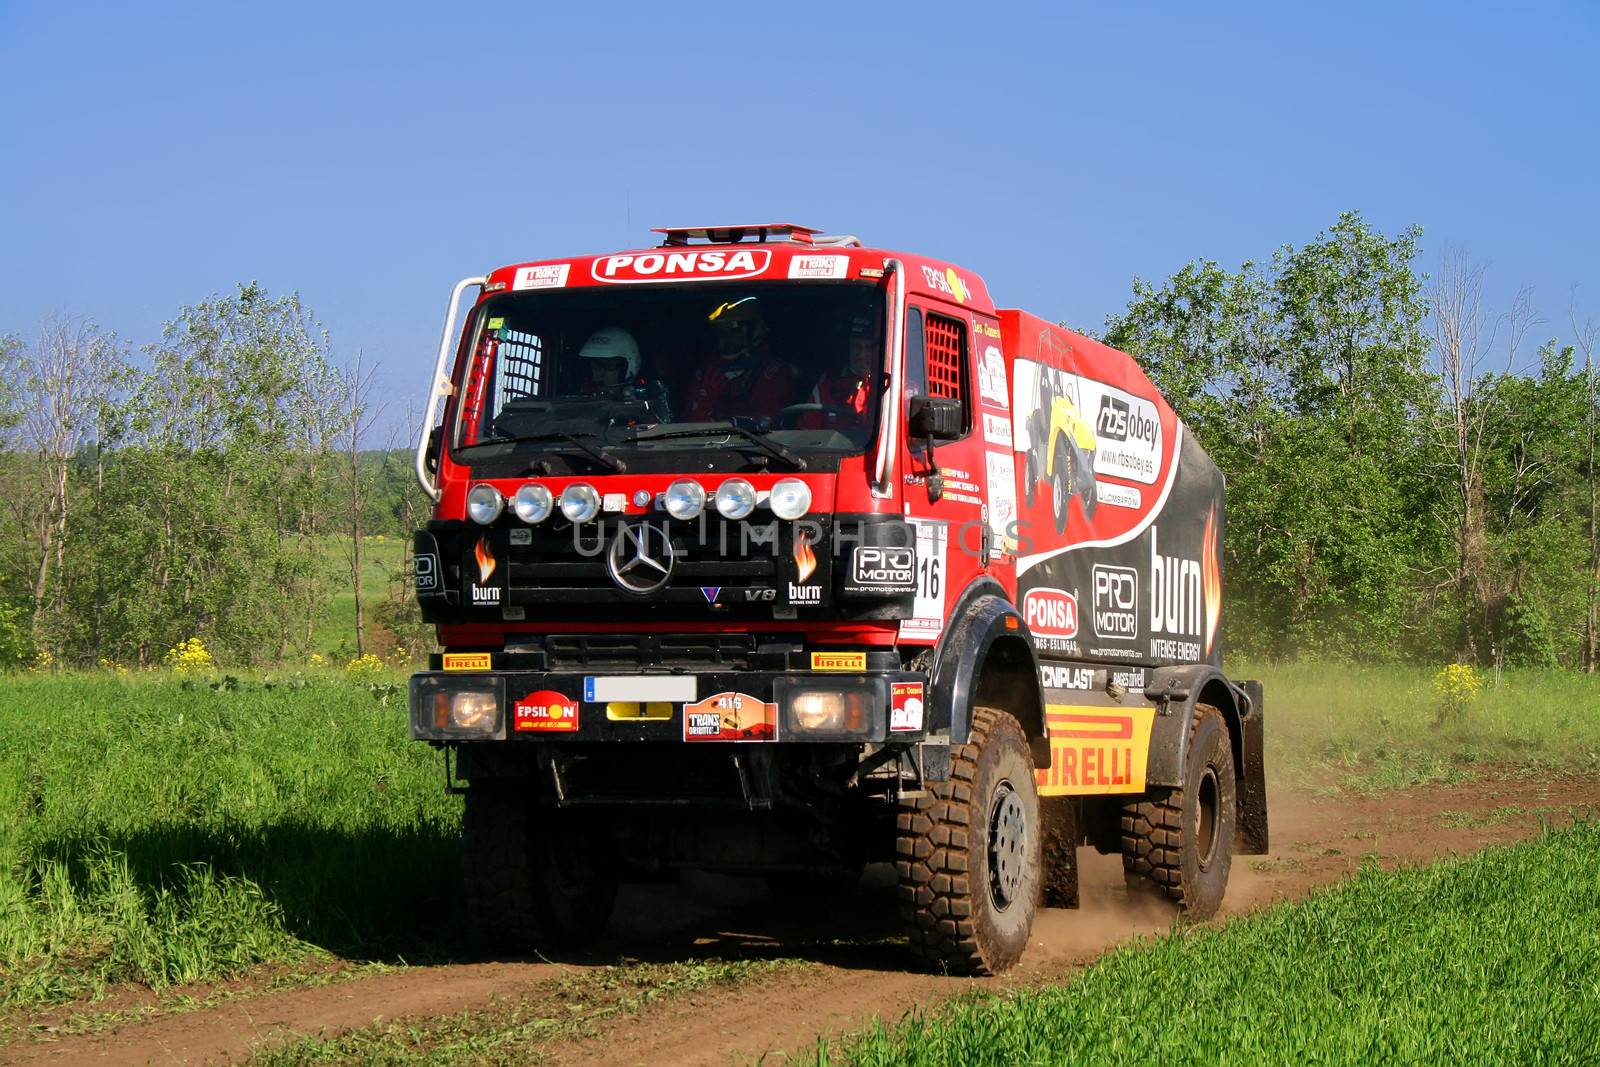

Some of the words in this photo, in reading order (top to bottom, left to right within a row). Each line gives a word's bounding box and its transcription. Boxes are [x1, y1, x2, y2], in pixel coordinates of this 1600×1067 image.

[605, 251, 756, 276] PONSA
[1101, 449, 1153, 476] www.rbsobey.es
[859, 549, 912, 569] PRO
[860, 569, 912, 580] MOTOR
[914, 556, 940, 600] 16
[1151, 526, 1201, 636] burn
[472, 583, 500, 600] burn
[744, 589, 777, 601] V8
[788, 581, 821, 600] burn
[1095, 571, 1135, 610] PRO
[1027, 597, 1076, 631] PONSA
[1096, 611, 1135, 633] MOTOR
[1151, 638, 1177, 660] INTENSE
[1177, 640, 1201, 662] ENERGY
[445, 655, 488, 668] PIRELLI
[813, 654, 863, 668] PIRELLI
[718, 697, 742, 709] 416
[688, 713, 720, 727] TRANS
